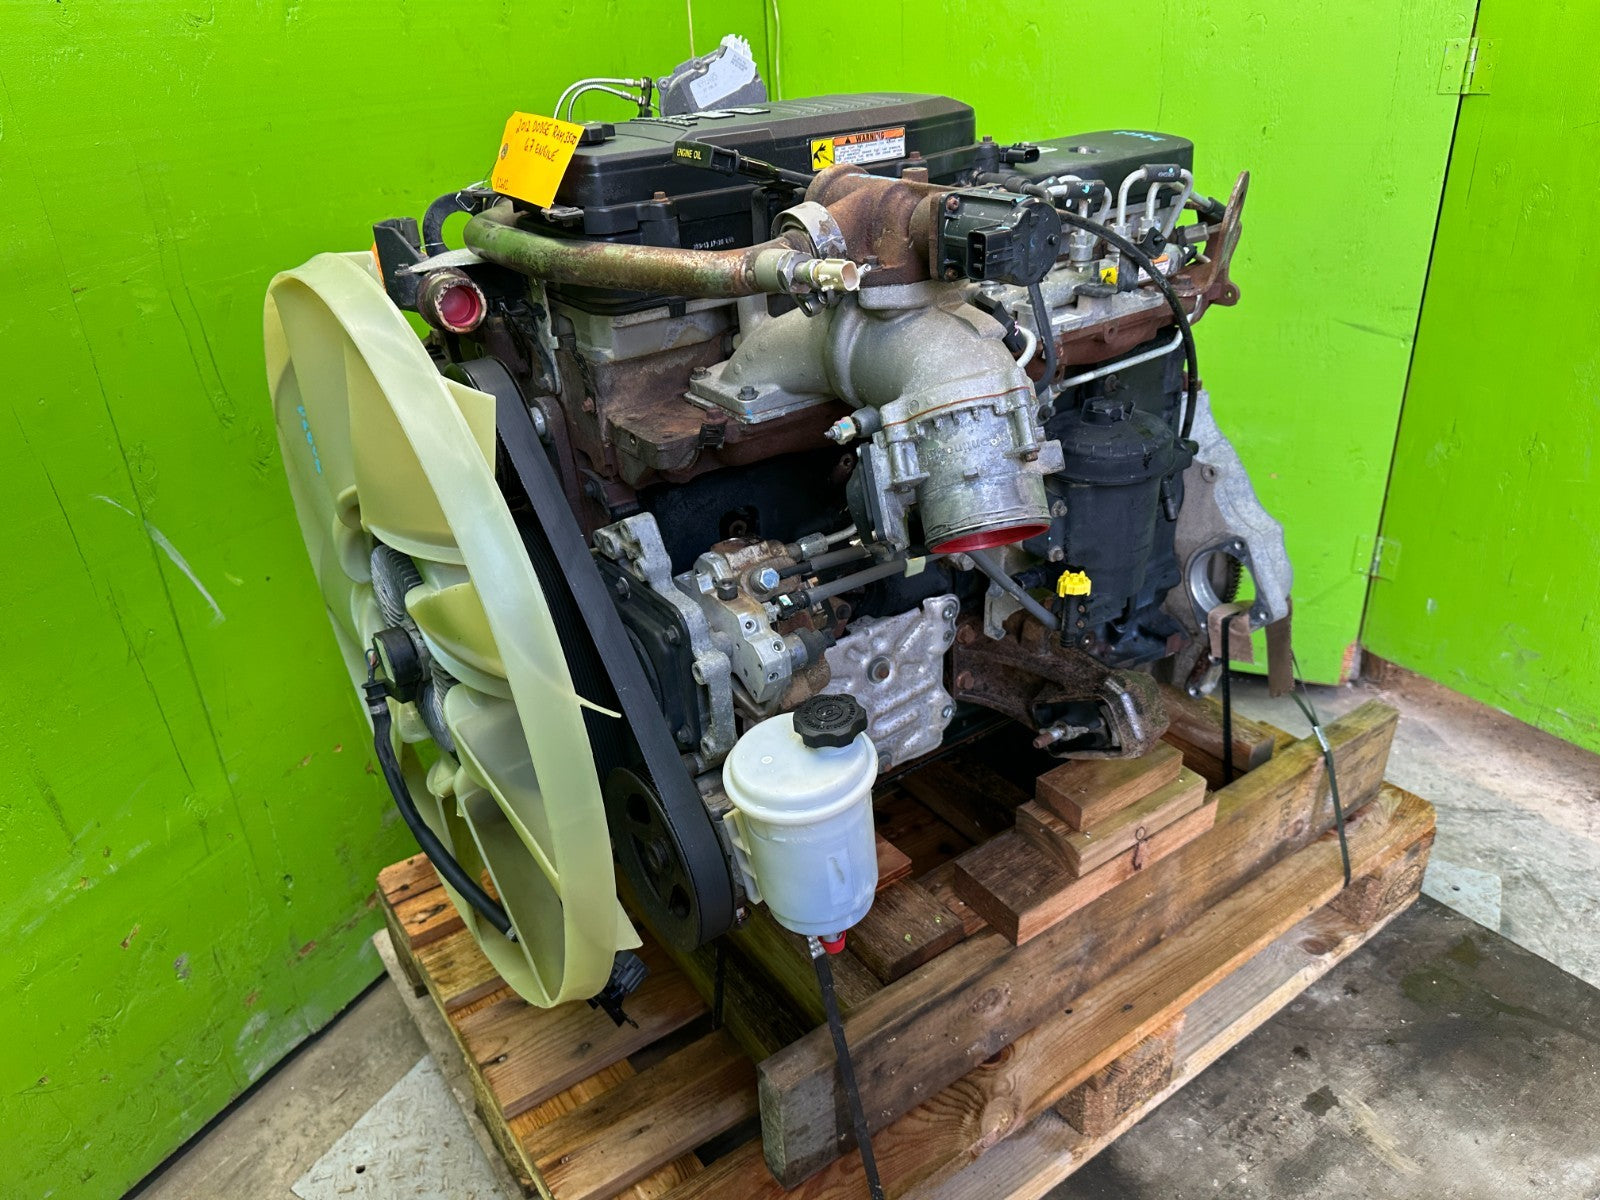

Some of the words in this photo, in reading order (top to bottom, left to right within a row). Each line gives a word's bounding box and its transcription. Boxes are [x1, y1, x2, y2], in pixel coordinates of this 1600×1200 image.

[855, 132, 885, 143] WARNING
[535, 143, 560, 162] ENGINE
[676, 147, 693, 159] ENGINE
[693, 150, 702, 161] OIL
